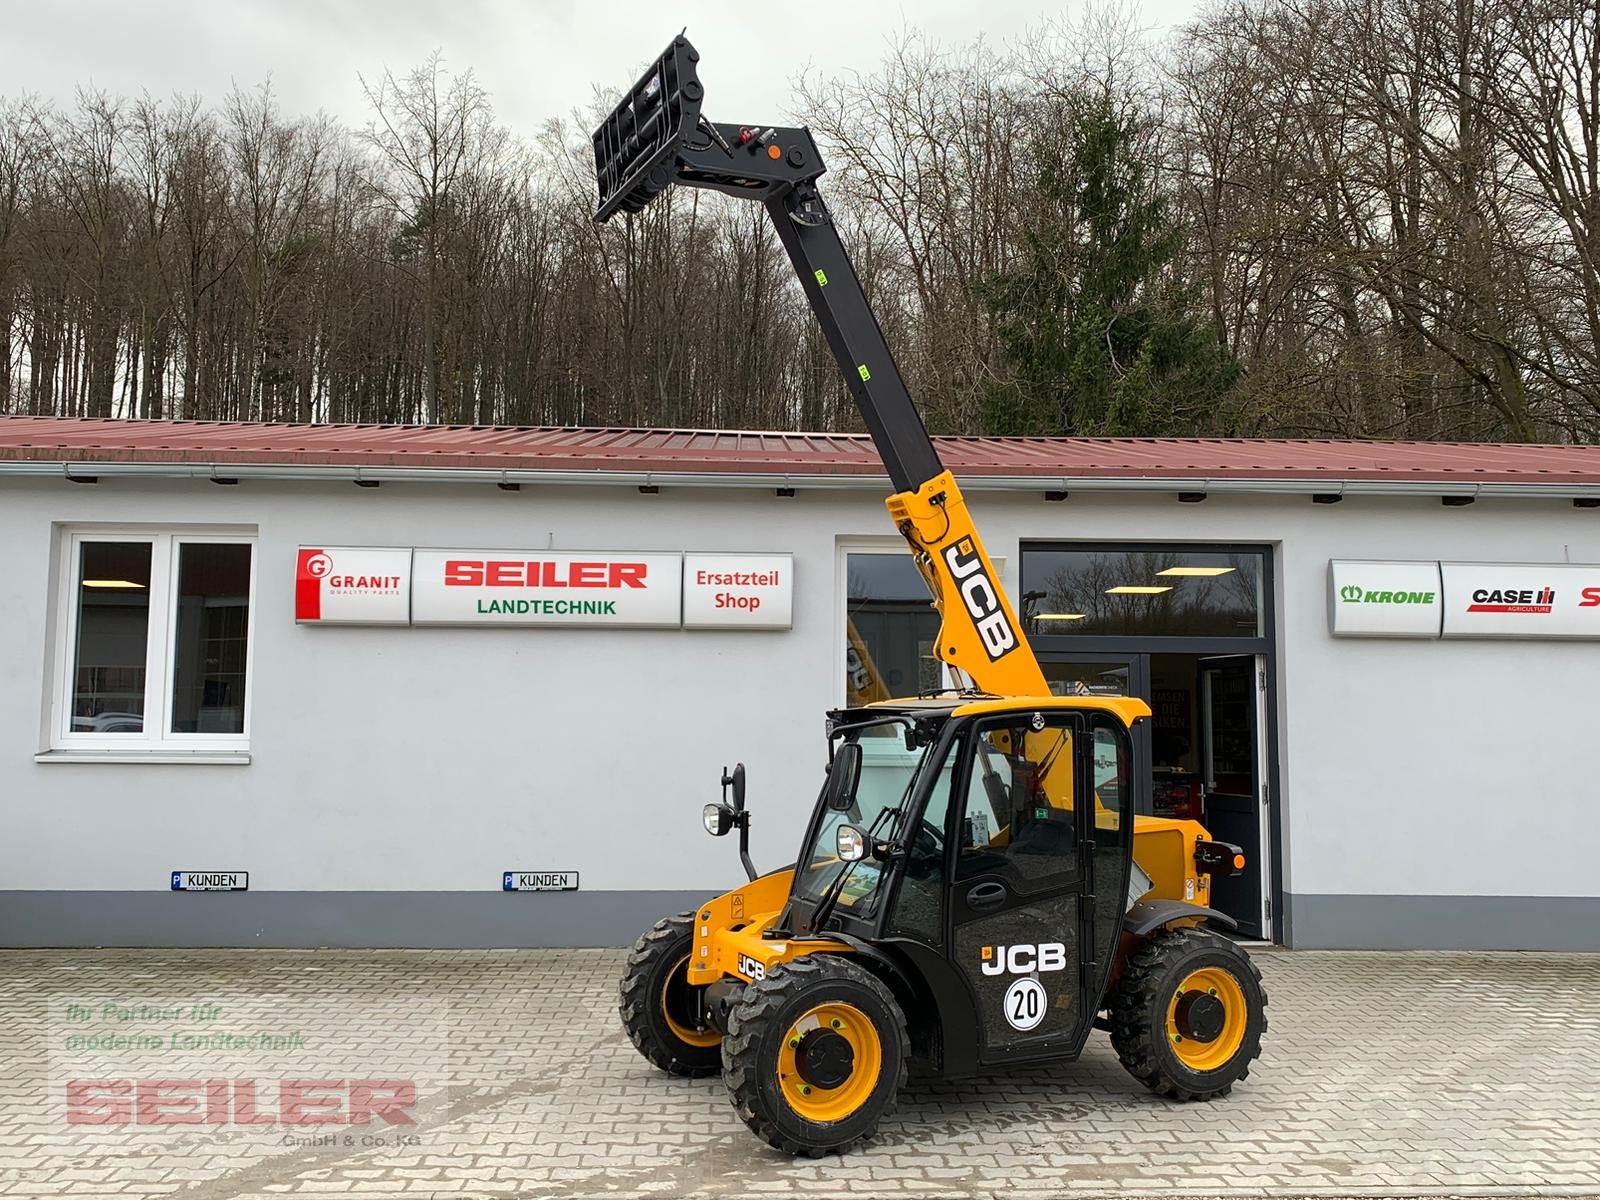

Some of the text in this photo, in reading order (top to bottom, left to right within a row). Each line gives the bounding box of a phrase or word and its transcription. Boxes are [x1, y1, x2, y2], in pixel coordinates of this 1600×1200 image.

[330, 575, 401, 589] GRANIT
[445, 560, 647, 589] SEILER
[696, 569, 779, 588] Ersatzteil
[373, 589, 400, 597] PARTS
[714, 592, 761, 611] Shop
[945, 545, 1015, 658] JCB
[1363, 591, 1436, 605] KRONE
[1472, 589, 1533, 604] CASE
[477, 598, 617, 616] LANDTECHNIK
[173, 874, 237, 887] P KUNDEN
[504, 874, 568, 887] P KUNDEN
[738, 955, 766, 981] JCB
[981, 942, 1067, 976] JCB
[1013, 988, 1038, 1021] 20
